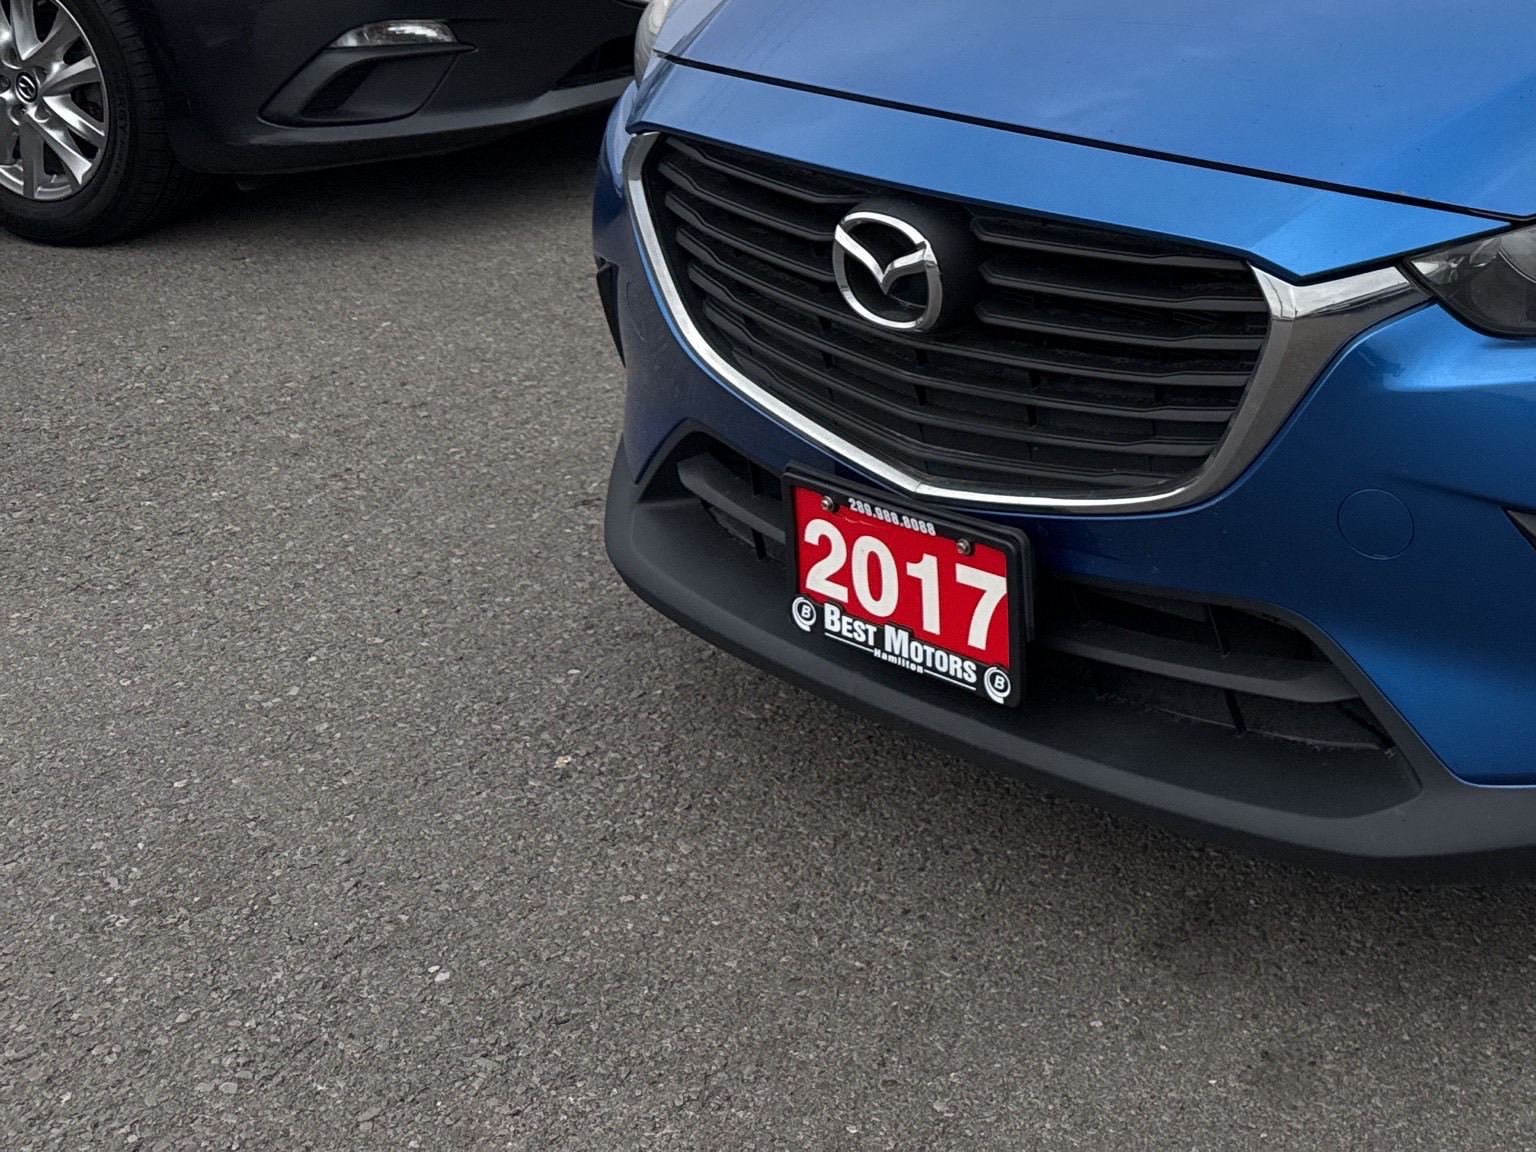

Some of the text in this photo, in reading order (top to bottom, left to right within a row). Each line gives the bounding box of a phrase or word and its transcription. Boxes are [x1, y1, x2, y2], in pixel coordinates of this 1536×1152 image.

[848, 497, 937, 537] 289.988.8088
[803, 518, 1008, 651] 2017
[824, 602, 978, 684] BEST MOTORS
[872, 647, 925, 674] Hamilton
